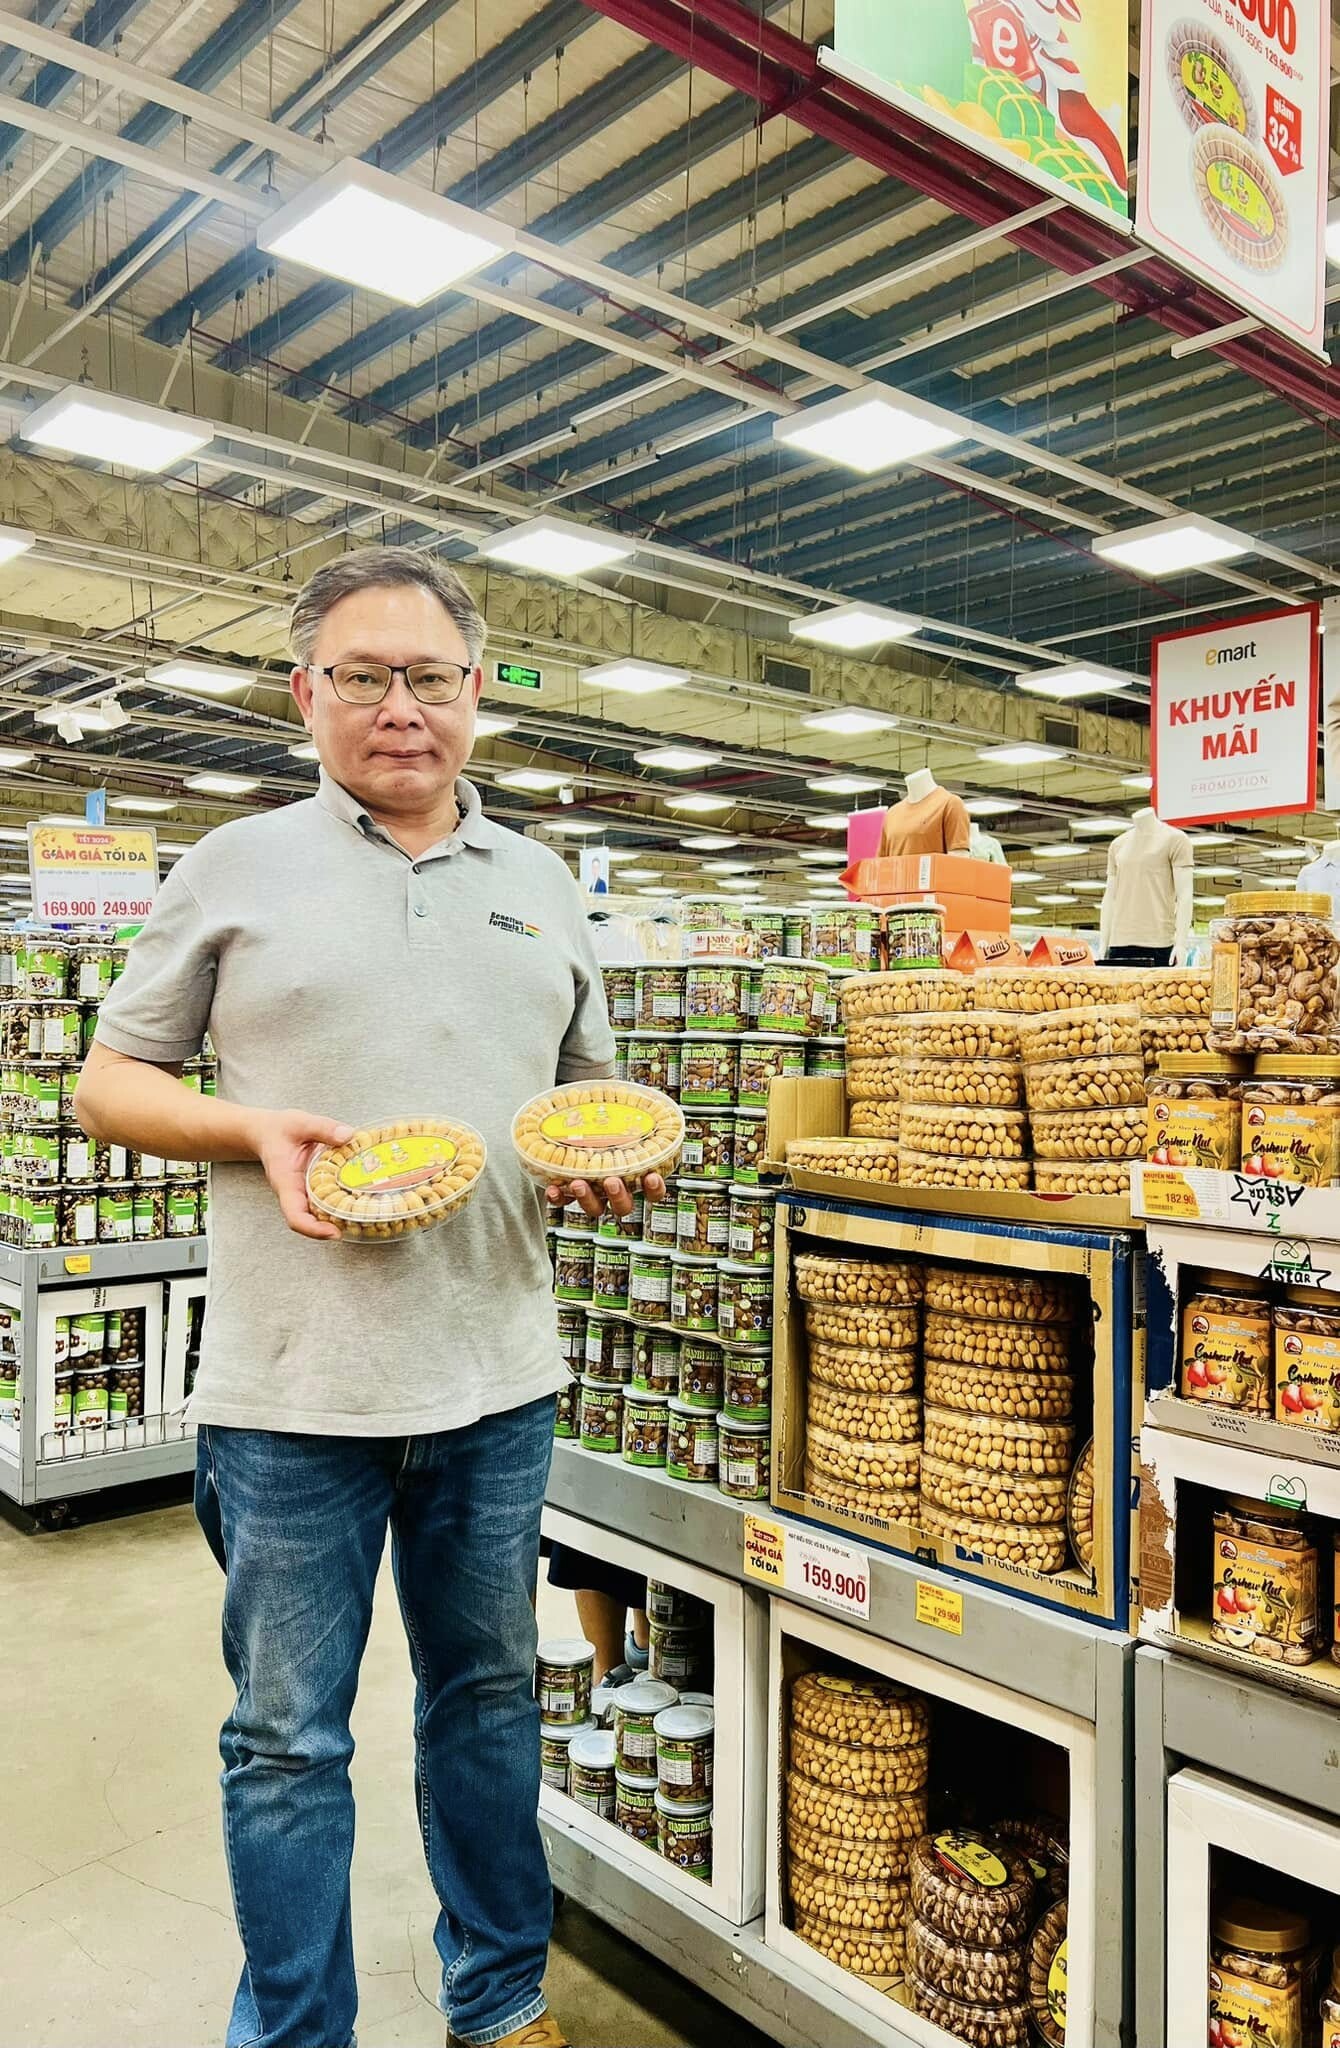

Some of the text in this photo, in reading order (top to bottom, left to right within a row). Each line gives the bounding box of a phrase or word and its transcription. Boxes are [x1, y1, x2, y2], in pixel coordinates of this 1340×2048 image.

[1205, 641, 1257, 666] emart
[1169, 673, 1296, 727] KHUYẾN
[1202, 723, 1258, 760] MÃI
[1191, 775, 1269, 794] PROMOTION
[78, 848, 102, 861] GIÁ
[103, 846, 125, 862] TỐI
[127, 851, 148, 862] ĐA
[42, 901, 96, 917] 169.900
[1191, 1133, 1212, 1150] Nut
[1289, 1138, 1312, 1157] Nut
[750, 1555, 765, 1571] TỐI
[768, 1546, 784, 1562] GIÁ
[802, 1561, 866, 1603] 159.900
[1260, 1578, 1283, 1597] Nut
[934, 1606, 961, 1624] 129.900
